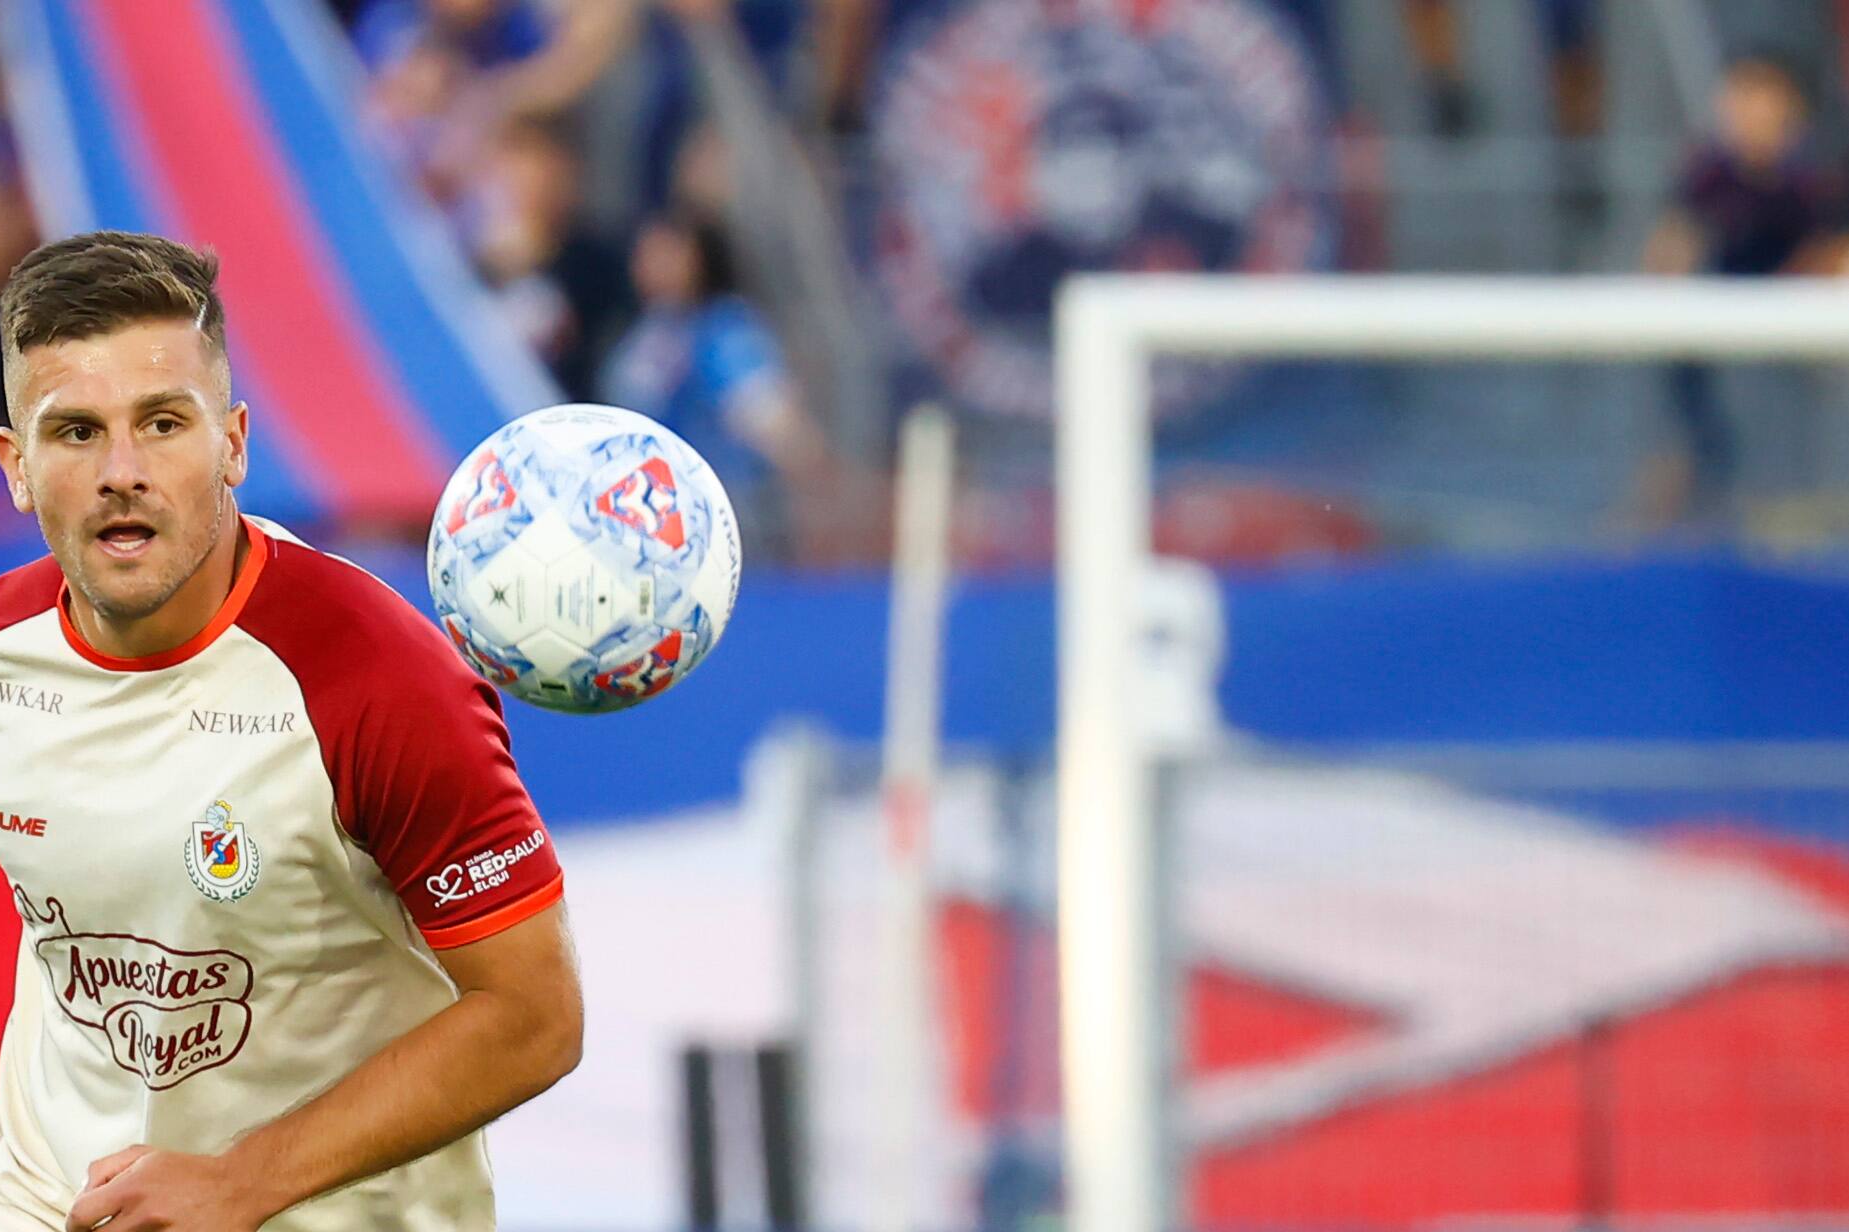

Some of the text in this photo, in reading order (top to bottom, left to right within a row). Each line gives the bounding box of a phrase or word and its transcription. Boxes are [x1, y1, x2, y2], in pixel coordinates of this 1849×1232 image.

[188, 709, 295, 735] NEWKAR
[468, 829, 545, 882] REDSALUD
[473, 870, 510, 893] ELQUI
[64, 945, 230, 1005] Apuestas
[118, 1004, 223, 1078] Royal
[173, 1044, 221, 1076] .COM
